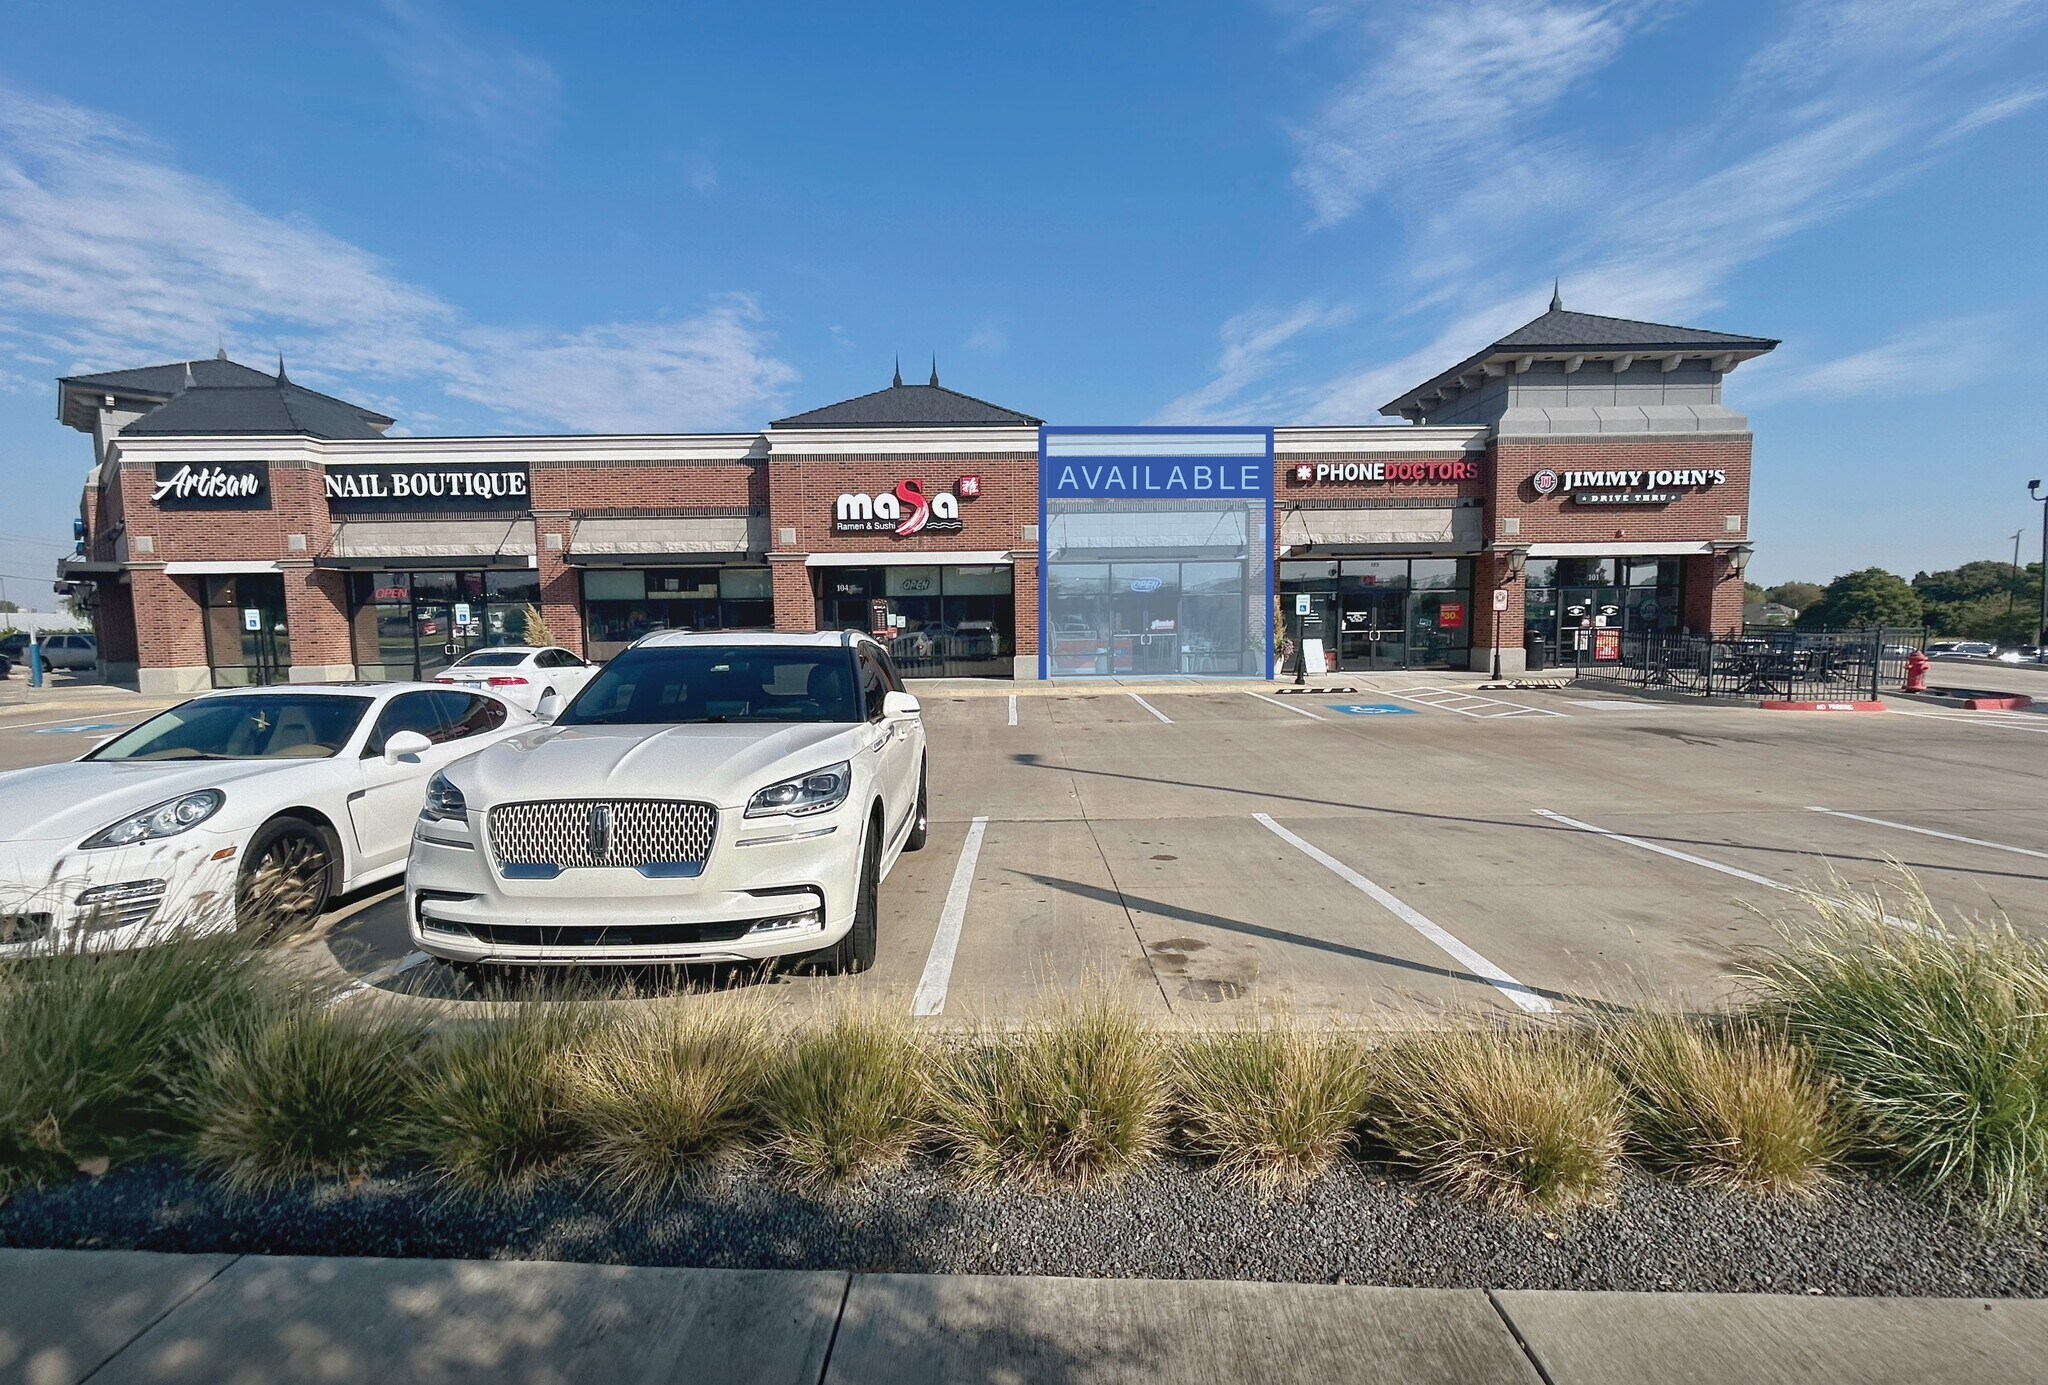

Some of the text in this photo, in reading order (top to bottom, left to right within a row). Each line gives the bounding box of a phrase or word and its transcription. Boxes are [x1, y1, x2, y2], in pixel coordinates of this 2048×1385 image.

[151, 464, 259, 500] Artisan
[1564, 469, 1726, 491] JIMMY JOHN'S
[323, 472, 527, 499] NAIL BOUTIQUE
[1591, 494, 1667, 502] DRIVE THRU
[837, 521, 897, 531] Ramen & Sushi
[1588, 573, 1600, 581] 101
[836, 584, 849, 592] 104
[903, 580, 929, 590] OPEN
[1133, 580, 1159, 589] OPEN
[375, 588, 408, 599] OPEN
